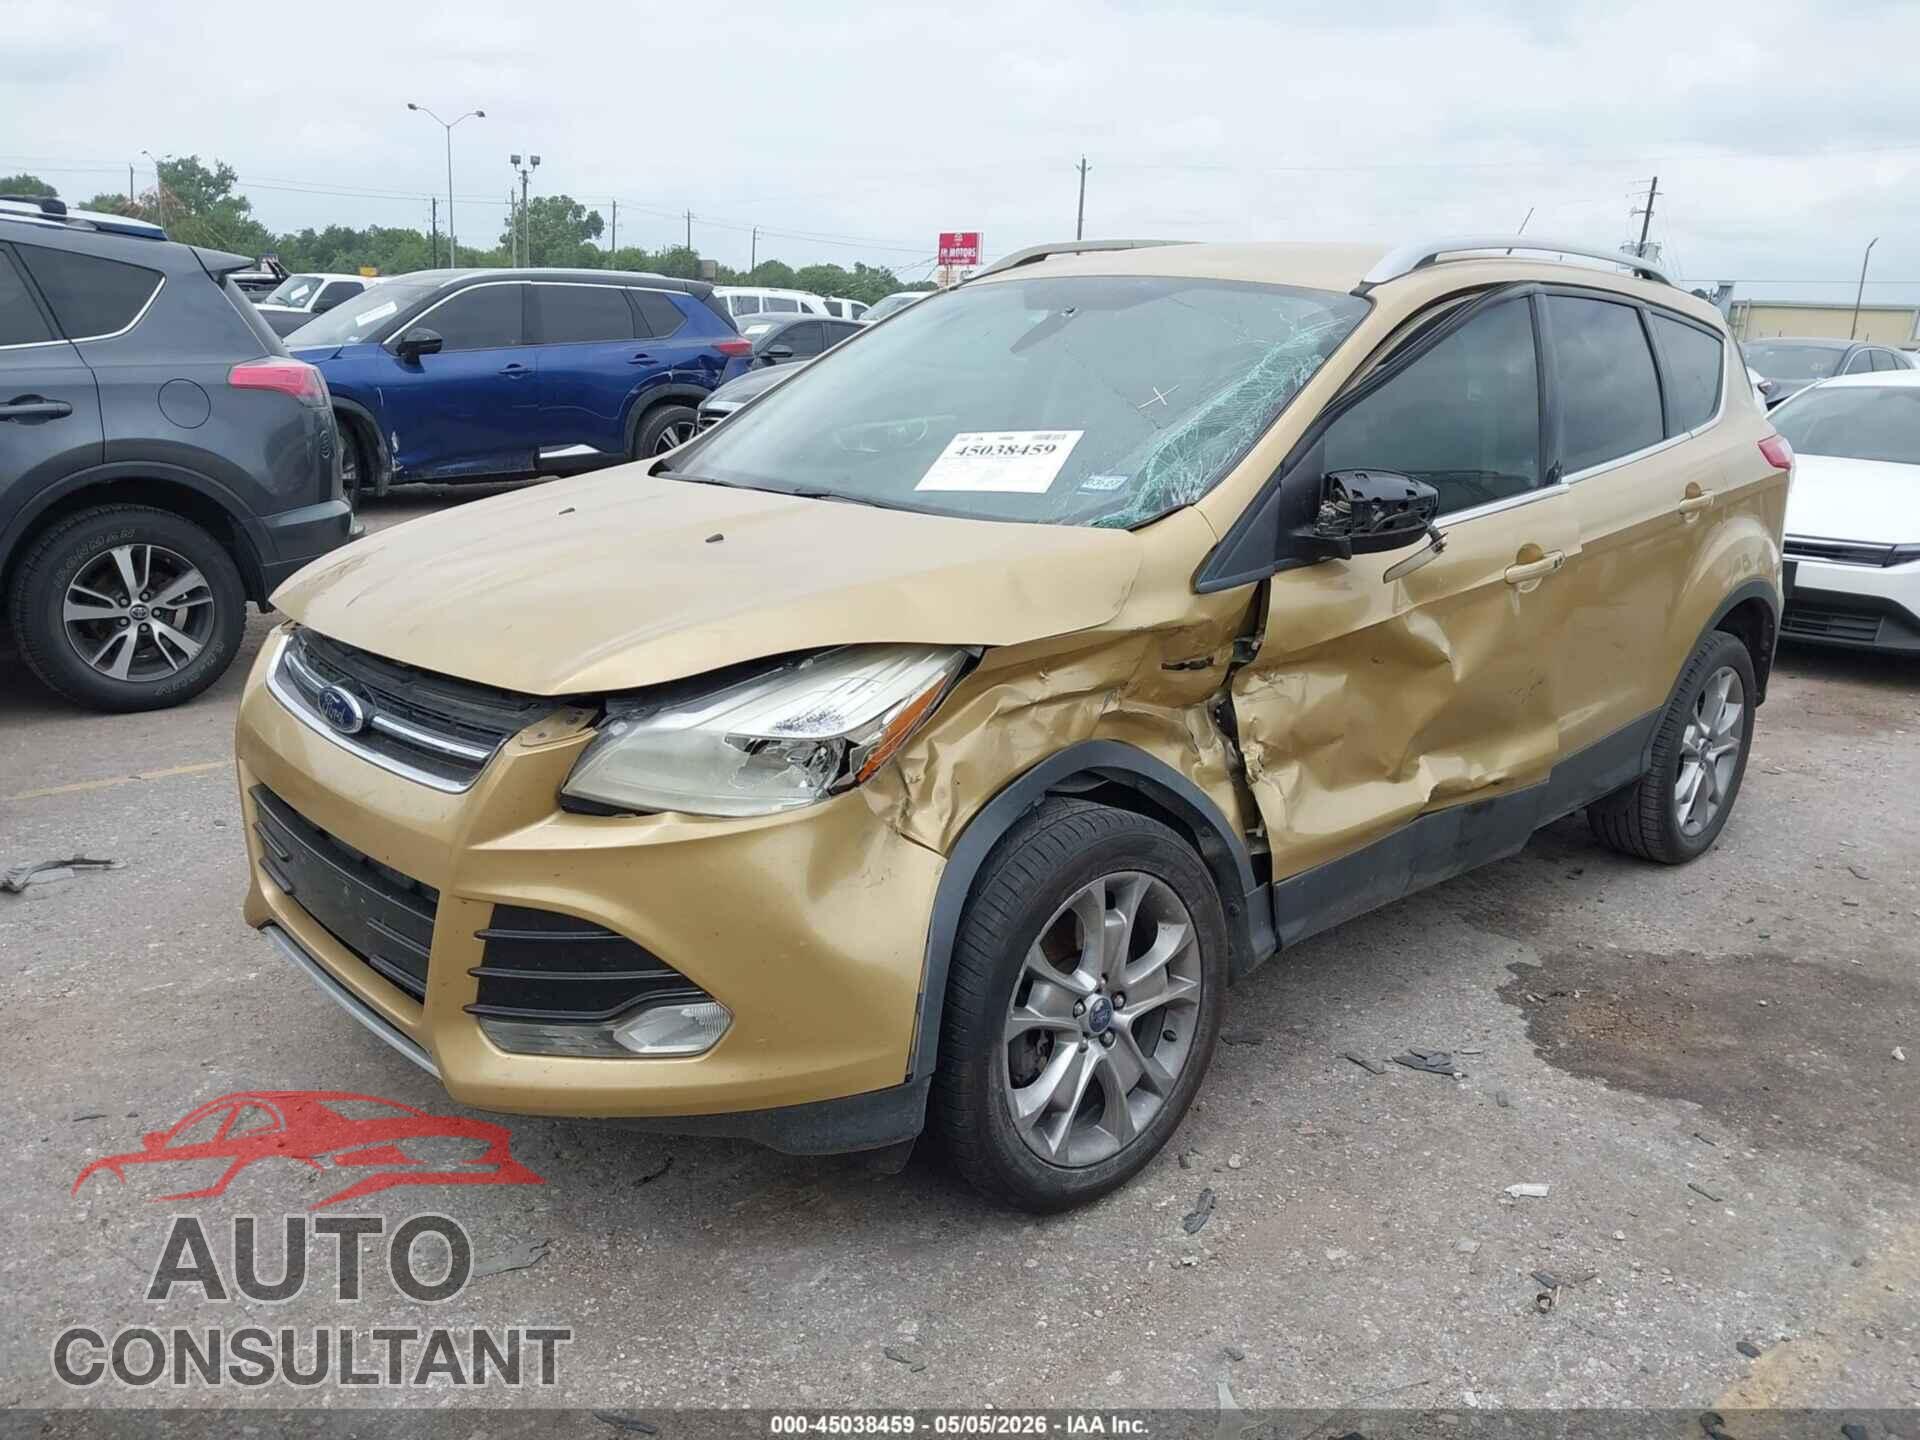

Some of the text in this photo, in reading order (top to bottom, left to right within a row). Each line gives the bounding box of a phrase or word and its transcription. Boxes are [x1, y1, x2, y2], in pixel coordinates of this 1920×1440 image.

[949, 248, 976, 257] MOTORS
[956, 444, 1057, 456] 45038459
[322, 691, 347, 725] Ford
